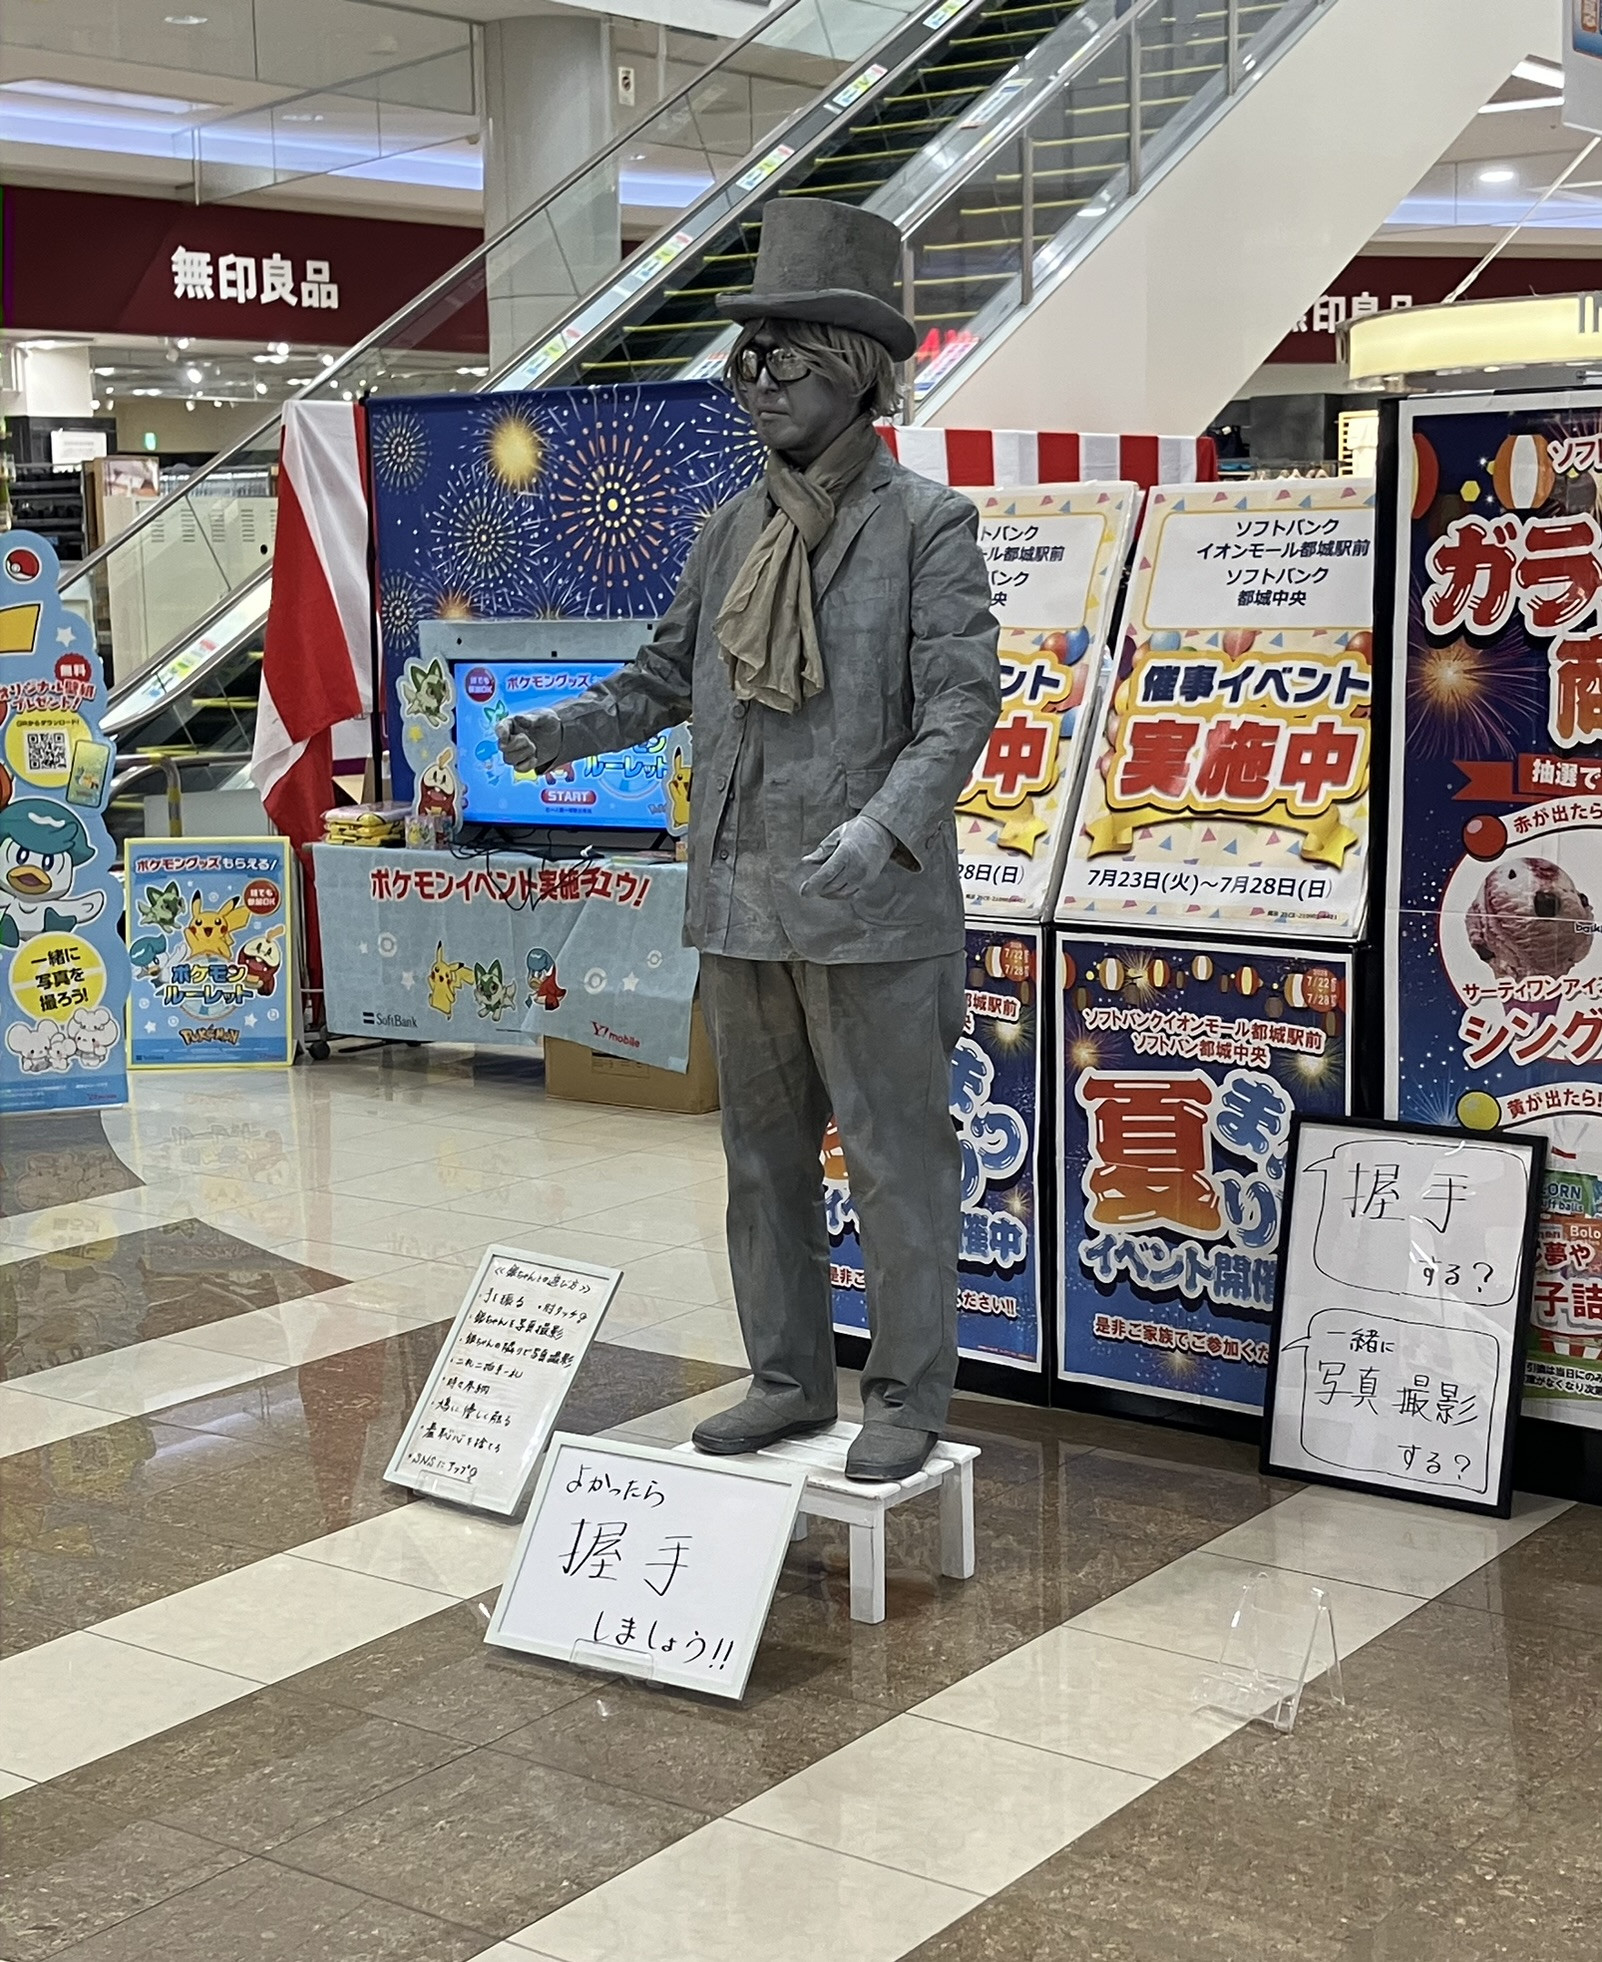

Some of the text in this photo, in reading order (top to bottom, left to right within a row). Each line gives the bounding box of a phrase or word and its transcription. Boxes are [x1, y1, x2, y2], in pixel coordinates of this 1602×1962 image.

[171, 245, 340, 310] 無印良品
[1292, 292, 1412, 333] 印良
[1236, 518, 1340, 537] ソフトバンク
[1196, 539, 1370, 560] イオンモール都城駅前
[1226, 567, 1329, 585] ソフトバンク
[1237, 590, 1307, 607] 都城中央
[1141, 663, 1370, 705] 催事イベント
[1120, 718, 1359, 803] 実施中
[548, 790, 589, 802] START
[31, 946, 82, 969] 一緒に
[35, 967, 85, 991] 写真を
[170, 963, 249, 985] ポケモン
[40, 986, 90, 1013] 撮ろう!
[163, 985, 254, 1008] ルーレット
[1463, 977, 1602, 1001] サーティワンアイ
[376, 1014, 418, 1028] SoftBank
[1086, 1010, 1324, 1051] ソフトバンクイオンモール都城駅前
[1536, 1241, 1591, 1267] 夢や
[1326, 1327, 1395, 1354] 一緒に
[565, 1463, 666, 1508] よかったら
[557, 1518, 694, 1597] 握手
[593, 1611, 735, 1671] しましょう!!
